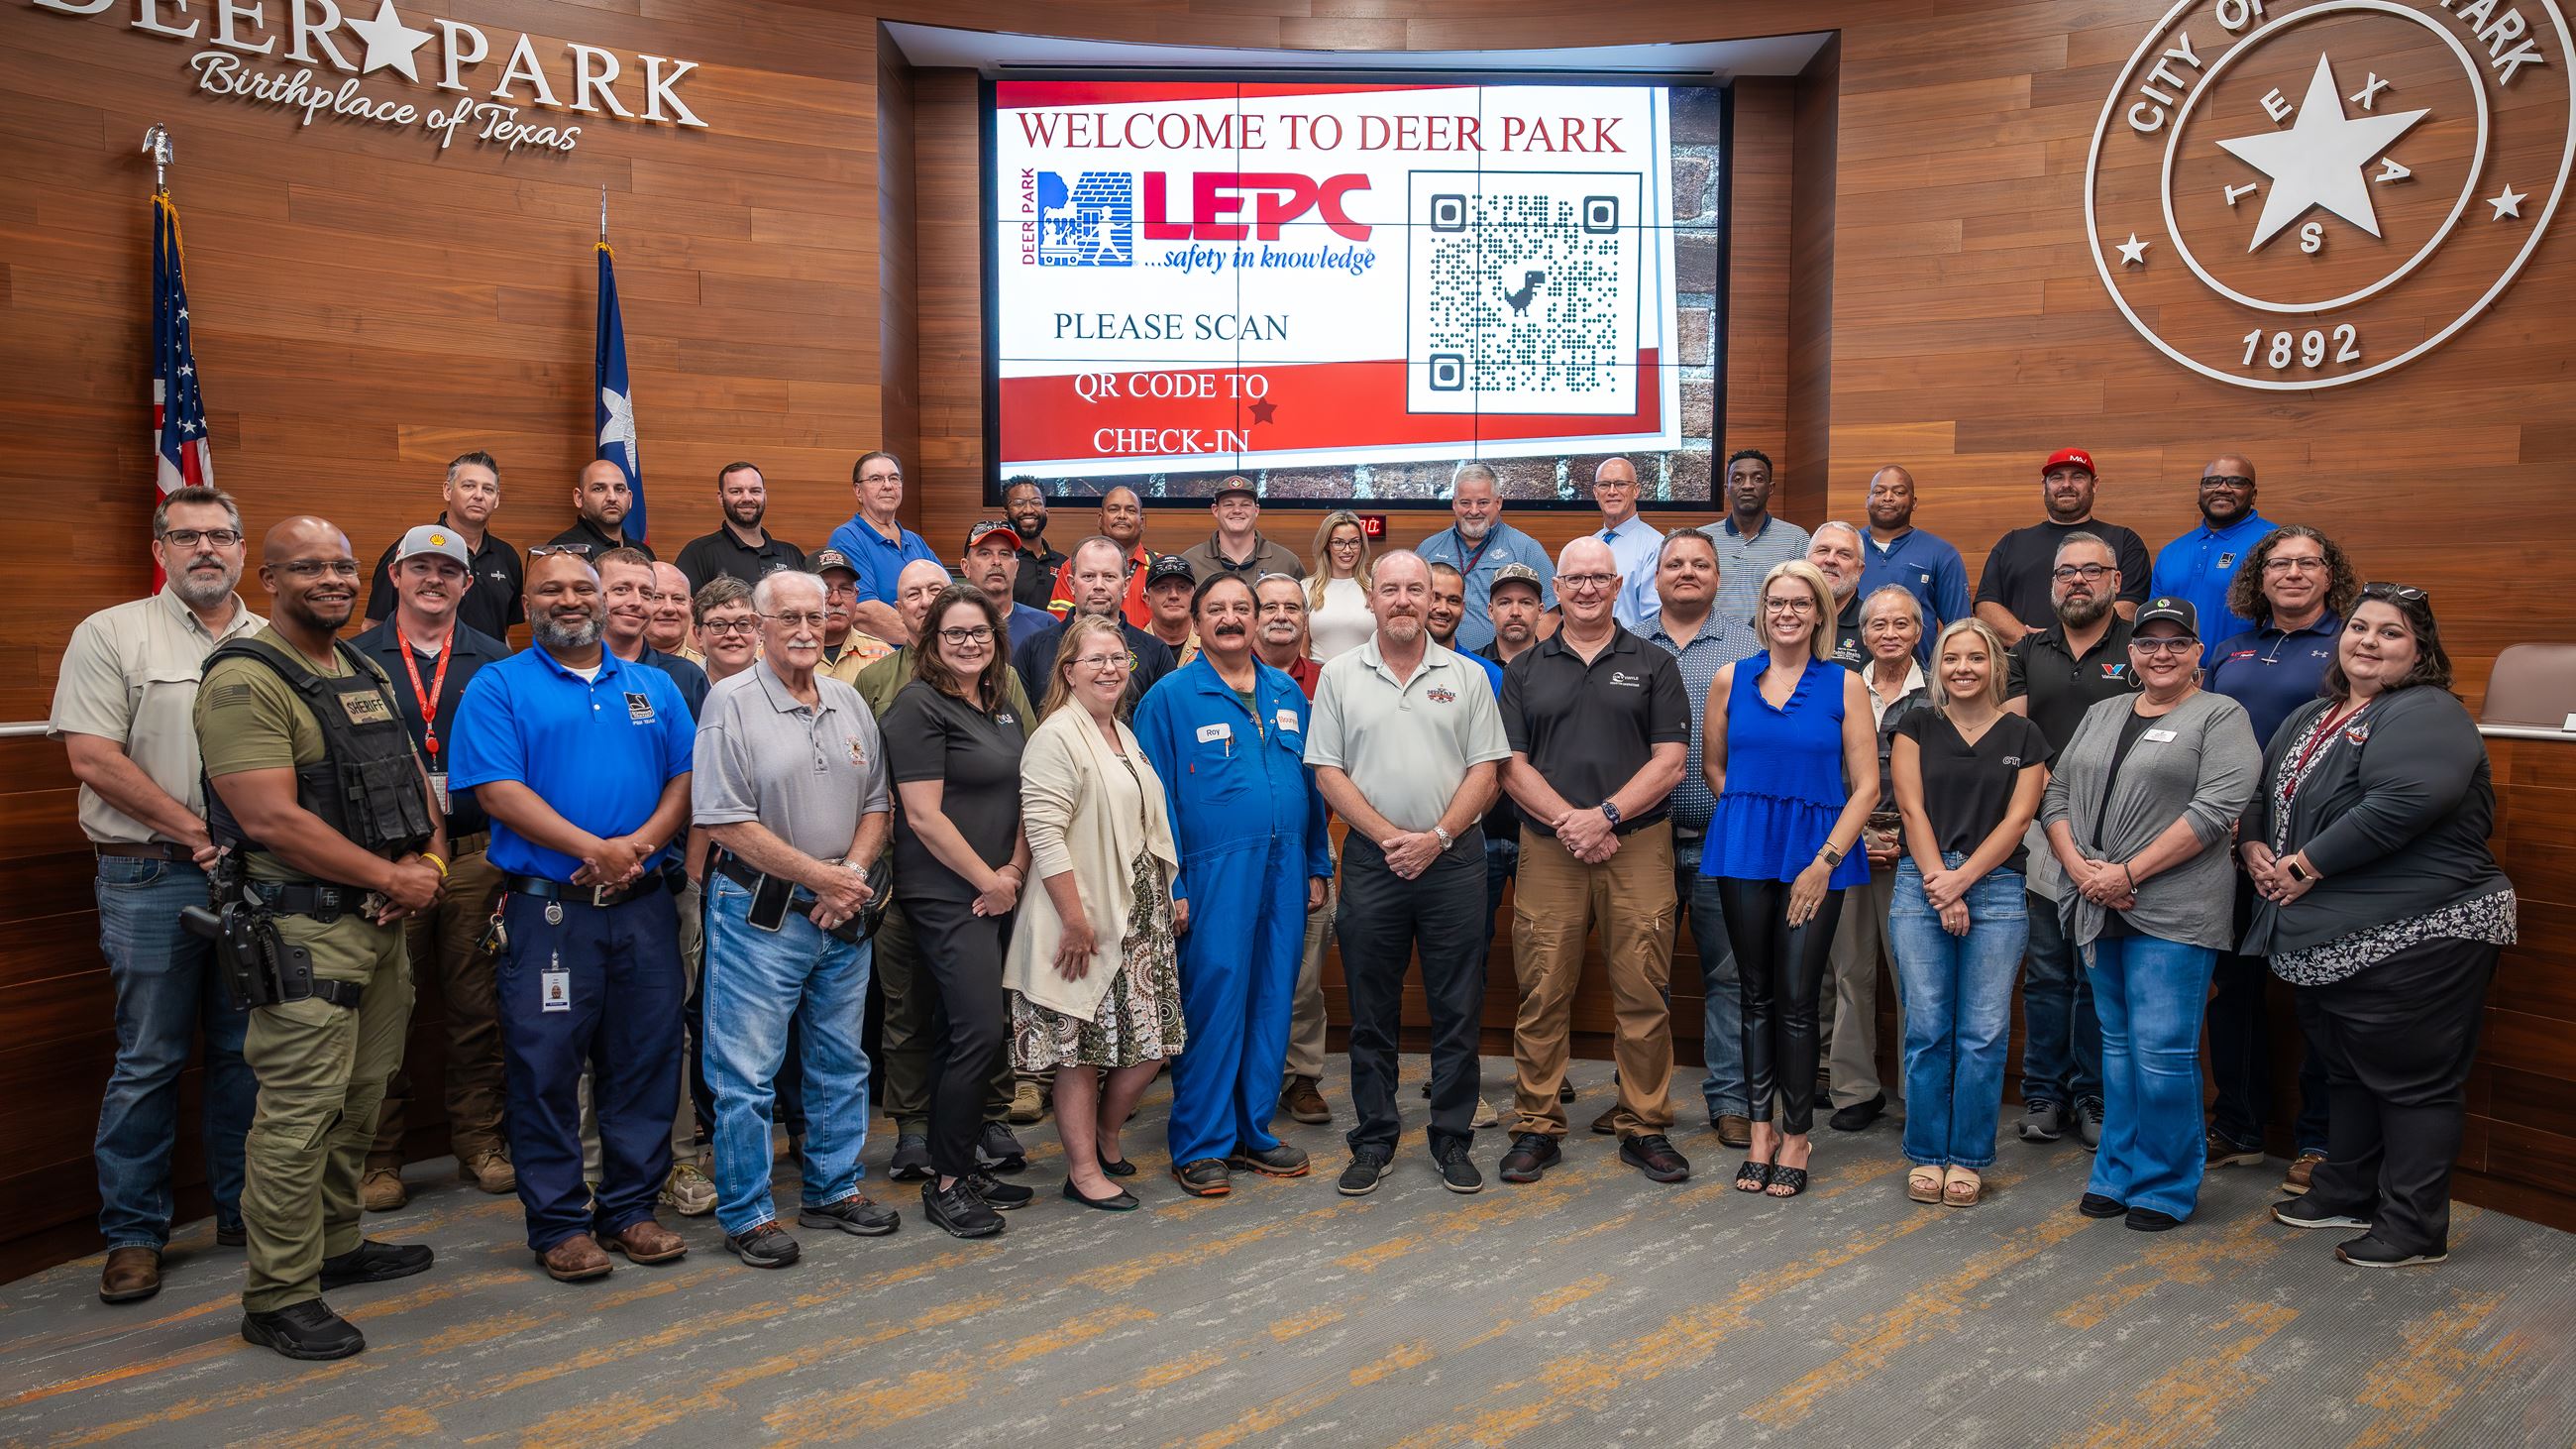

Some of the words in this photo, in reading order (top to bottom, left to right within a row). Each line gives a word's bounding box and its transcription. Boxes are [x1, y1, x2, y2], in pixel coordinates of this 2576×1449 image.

[33, 0, 359, 71] ER
[434, 18, 709, 128] PARK
[2440, 0, 2544, 86] ARK
[190, 51, 418, 126] Birthplace
[426, 96, 474, 149] of
[474, 102, 582, 151] Texas
[2127, 31, 2201, 132] CITY
[1016, 112, 1267, 150] WELCOME
[1280, 114, 1342, 151] TO
[1357, 115, 1487, 152] DEER
[1500, 116, 1627, 154] PARK
[1021, 167, 1035, 213] PARK
[1143, 171, 1372, 242] LEPC
[1021, 221, 1035, 265] DEER
[1234, 245, 1255, 268] in
[1053, 312, 1184, 340] PLEASE
[1195, 313, 1290, 341] SCAN
[2242, 323, 2361, 369] 1892
[1074, 372, 1121, 403] QR
[1127, 373, 1218, 398] CODE
[1225, 374, 1269, 398] TO
[1093, 427, 1251, 454] CHECK-IN
[347, 698, 385, 715] SHERIFF
